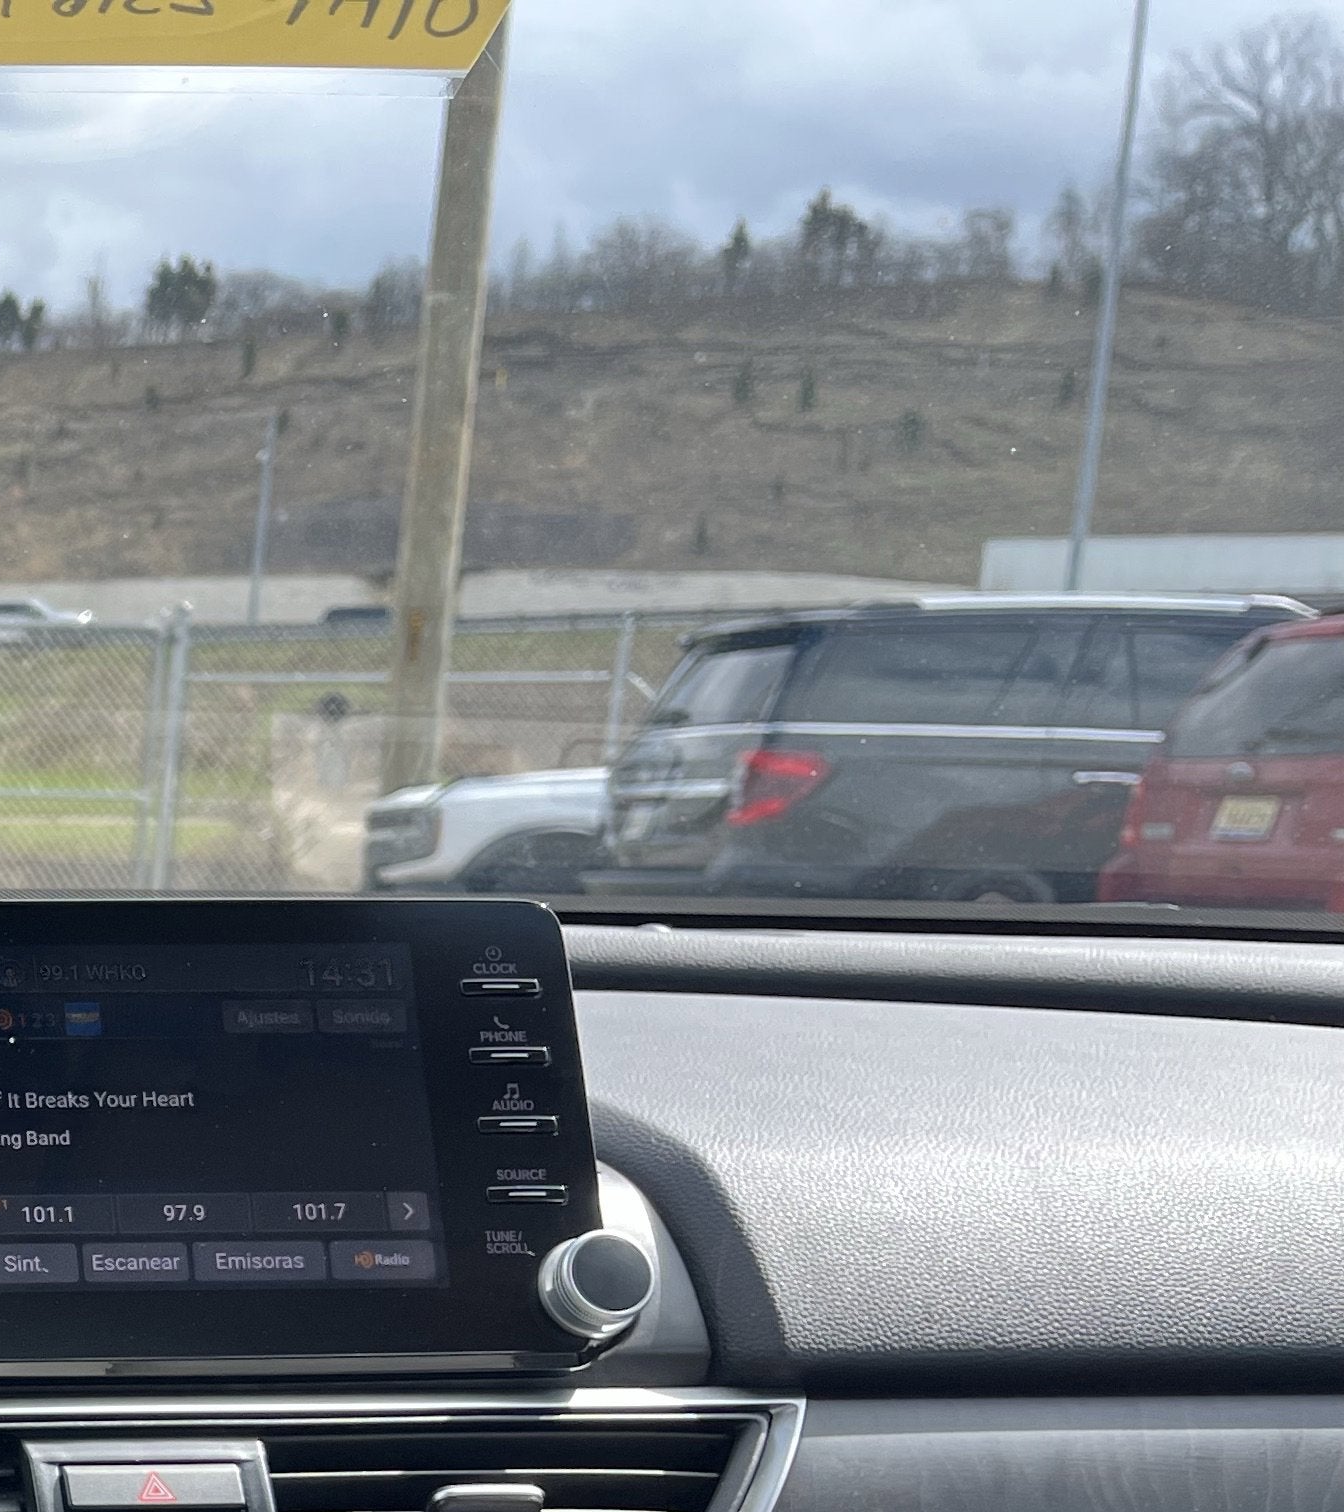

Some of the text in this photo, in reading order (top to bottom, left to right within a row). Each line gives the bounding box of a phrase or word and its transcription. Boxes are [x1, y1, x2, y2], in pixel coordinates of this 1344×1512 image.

[86, 964, 147, 982] WHKO
[301, 958, 395, 986] 14:31
[473, 962, 518, 975] CLOCK
[237, 1009, 299, 1027] Ajustes
[479, 1030, 528, 1043] PHONE
[7, 1091, 21, 1109] It
[24, 1090, 90, 1109] Breaks
[93, 1090, 138, 1109] Your
[142, 1090, 195, 1108] Heart
[492, 1099, 535, 1112] AUDIO
[26, 1129, 71, 1147] Band
[496, 1168, 547, 1181] SOURCE
[20, 1205, 75, 1223] 101.1
[163, 1204, 206, 1223] 97.9
[292, 1203, 346, 1222] 101.7
[485, 1230, 523, 1243] TUNE/
[486, 1242, 532, 1256] SCROLL
[91, 1253, 181, 1272] Escanear
[215, 1252, 305, 1271] Emisoras
[374, 1253, 411, 1265] Radio
